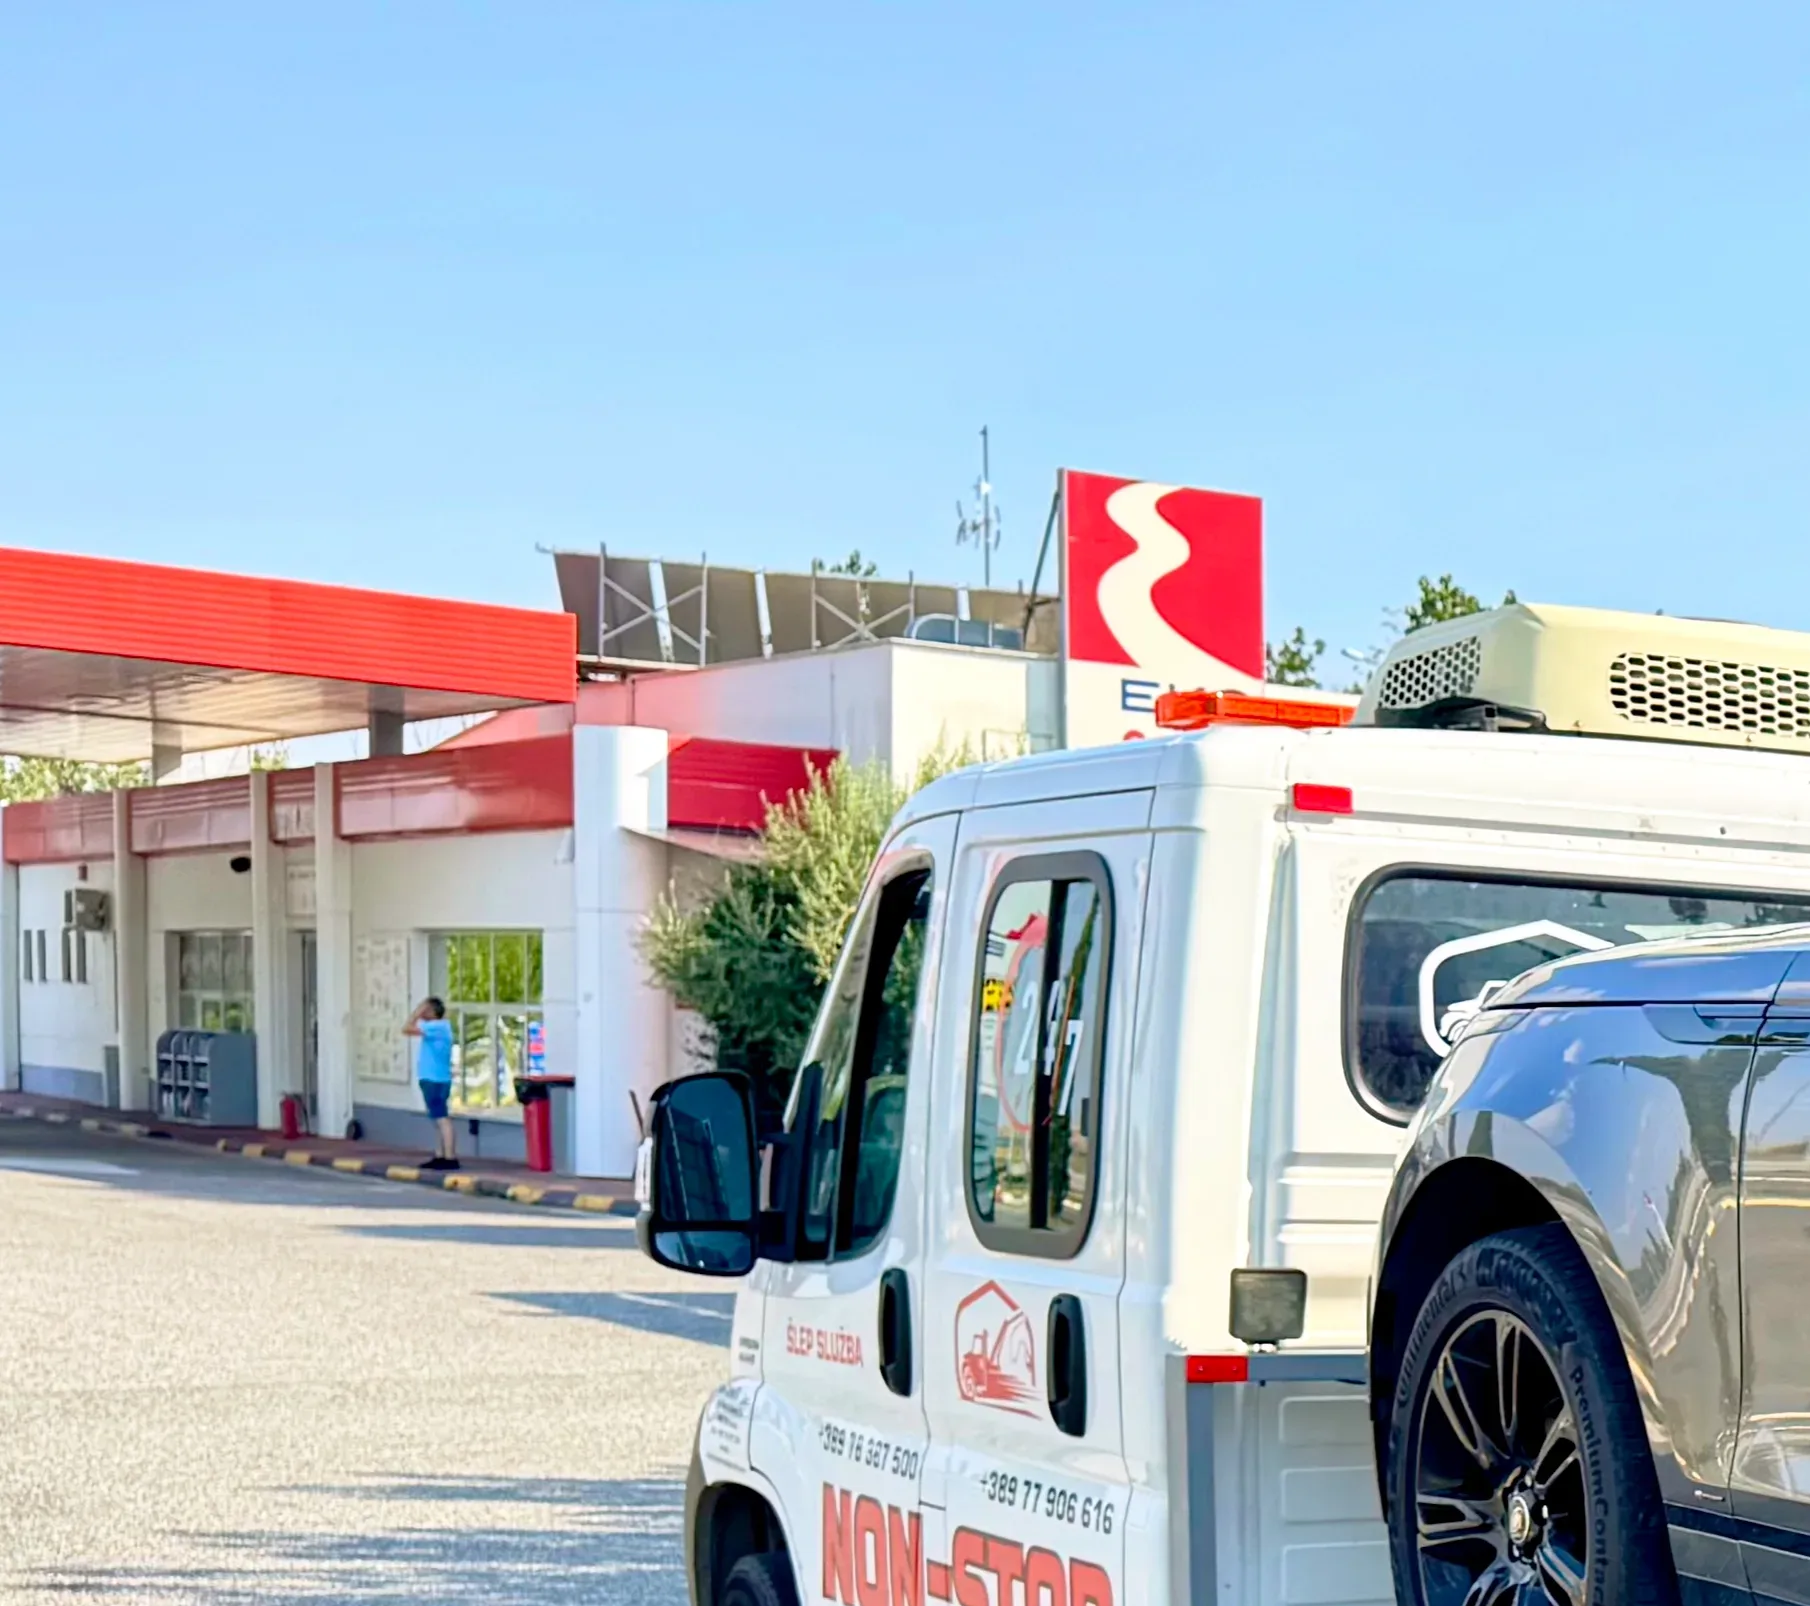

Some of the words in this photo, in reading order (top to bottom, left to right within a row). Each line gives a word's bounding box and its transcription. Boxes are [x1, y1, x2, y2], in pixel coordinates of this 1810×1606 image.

[891, 1445, 918, 1481] 500
[980, 1471, 1018, 1507] +389
[1022, 1479, 1042, 1513] 77
[1045, 1486, 1078, 1524] 906
[1081, 1496, 1114, 1535] 616
